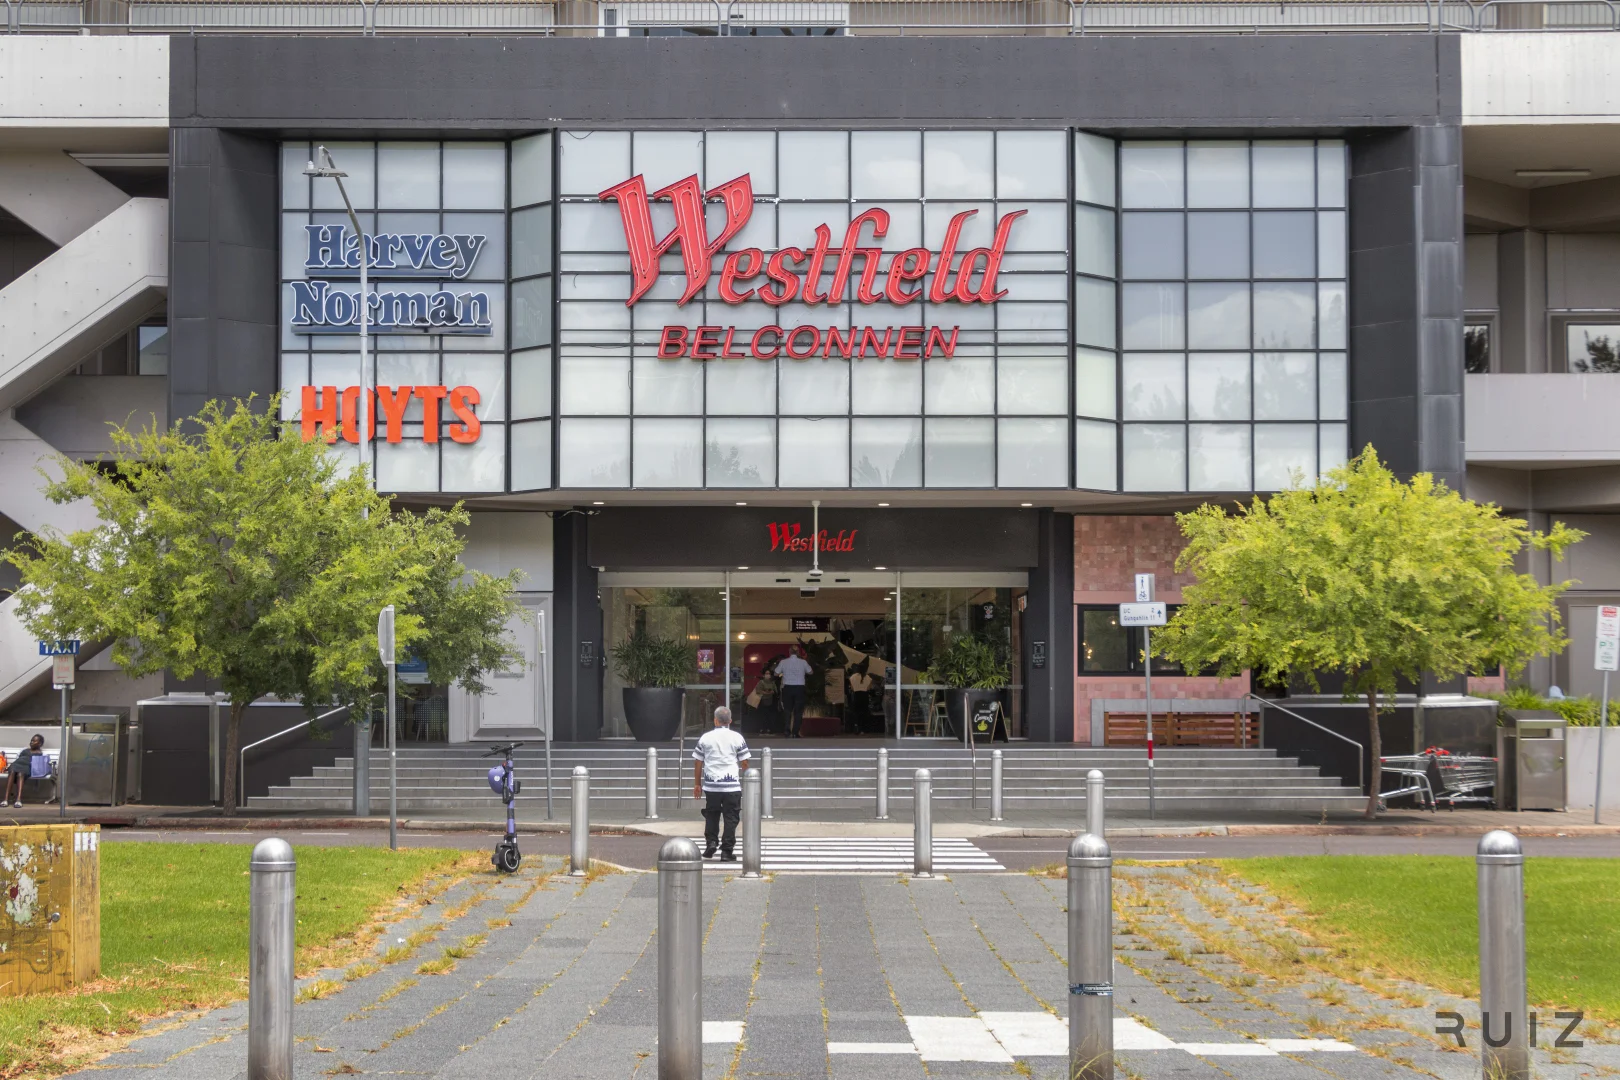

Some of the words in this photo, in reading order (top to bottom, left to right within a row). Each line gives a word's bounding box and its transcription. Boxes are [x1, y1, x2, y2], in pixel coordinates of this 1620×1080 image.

[303, 224, 487, 279] Harvey
[597, 172, 1029, 308] Westfield
[290, 281, 492, 326] Norman
[656, 325, 961, 360] BELCONNEN
[301, 385, 481, 445] HOYTS
[765, 521, 859, 552] Westfield
[42, 641, 77, 654] TAXI
